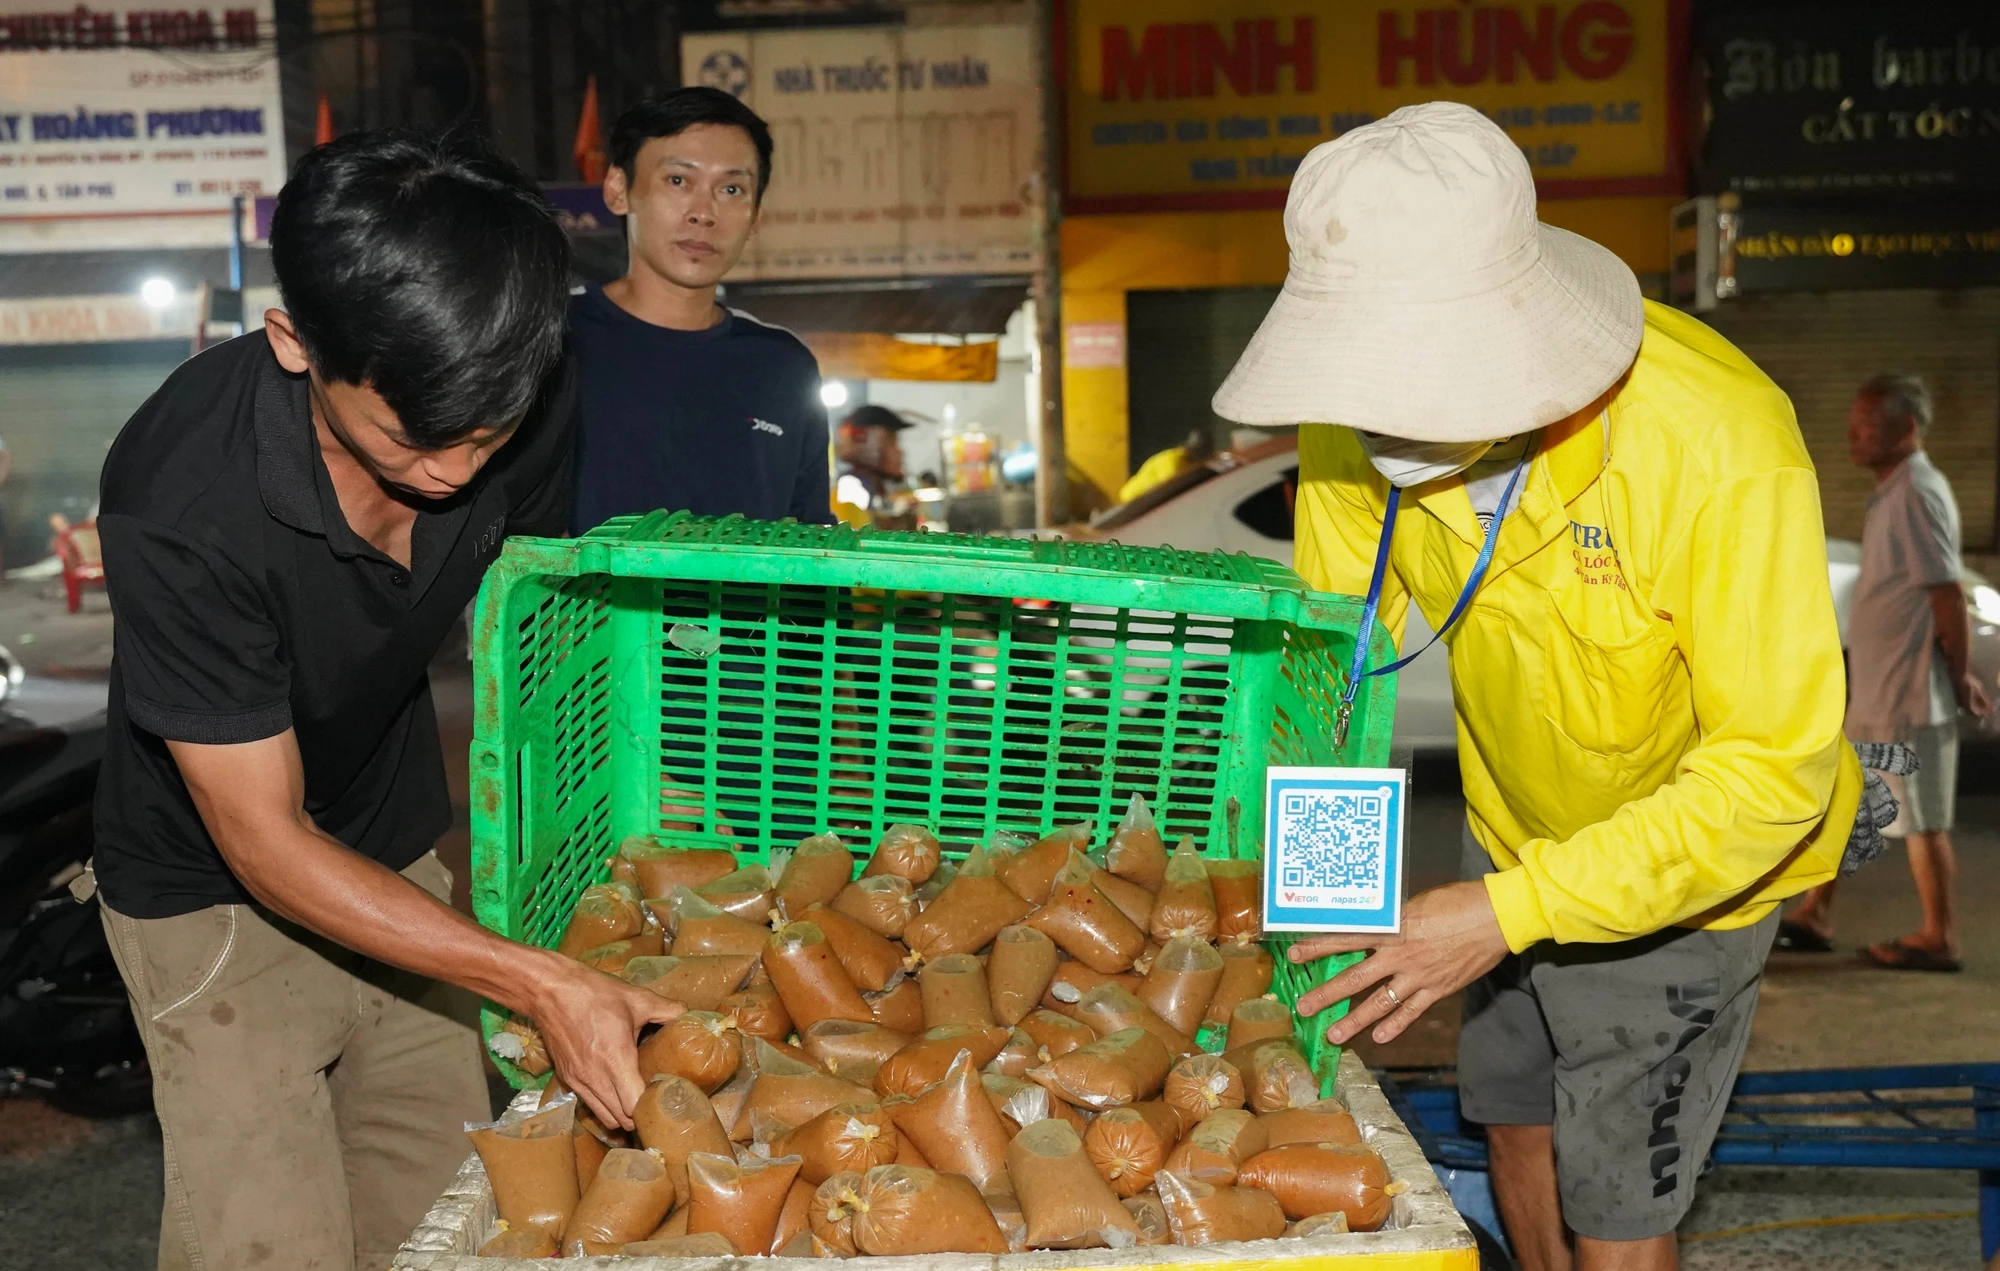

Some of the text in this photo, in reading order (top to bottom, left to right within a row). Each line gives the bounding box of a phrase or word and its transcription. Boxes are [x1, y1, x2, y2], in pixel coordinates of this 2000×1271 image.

[822, 57, 888, 93] THUỐC
[1102, 17, 1316, 99] MINH
[32, 105, 137, 141] HOÀNG
[1584, 554, 1611, 569] LÓC
[1331, 896, 1357, 905] napas
[1358, 896, 1376, 904] 247
